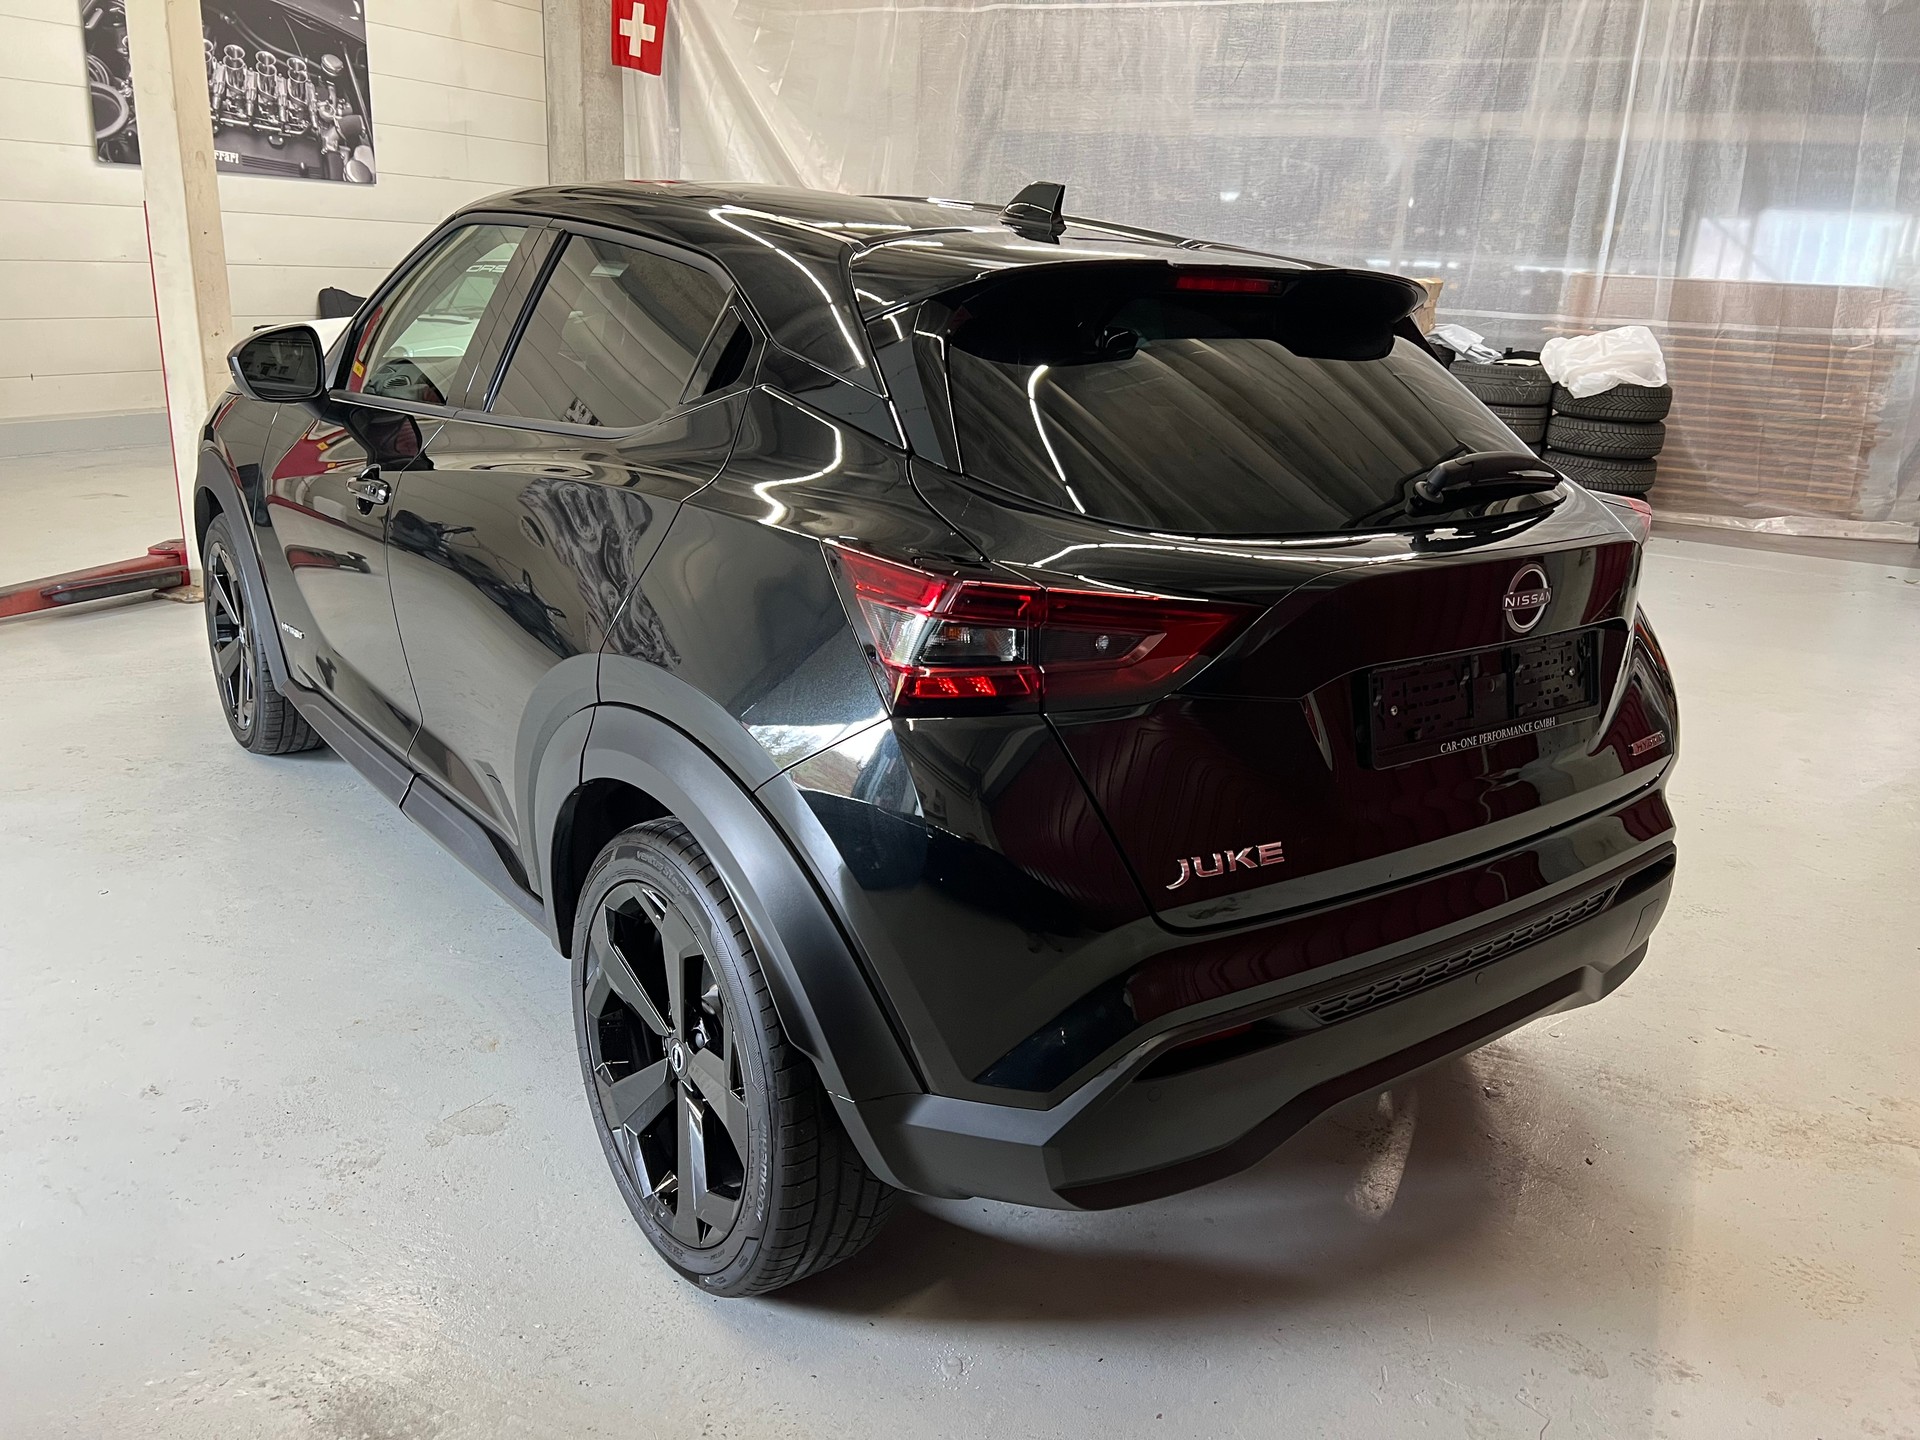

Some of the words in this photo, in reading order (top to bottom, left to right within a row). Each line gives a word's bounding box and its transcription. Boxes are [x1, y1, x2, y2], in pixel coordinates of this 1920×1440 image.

[214, 150, 239, 164] rrari
[1504, 591, 1551, 608] NISSAN
[1440, 735, 1478, 753] CAR-ONE
[1479, 721, 1533, 744] PERFORMANCE
[1533, 716, 1556, 730] GMBH
[1166, 841, 1285, 890] JUKE
